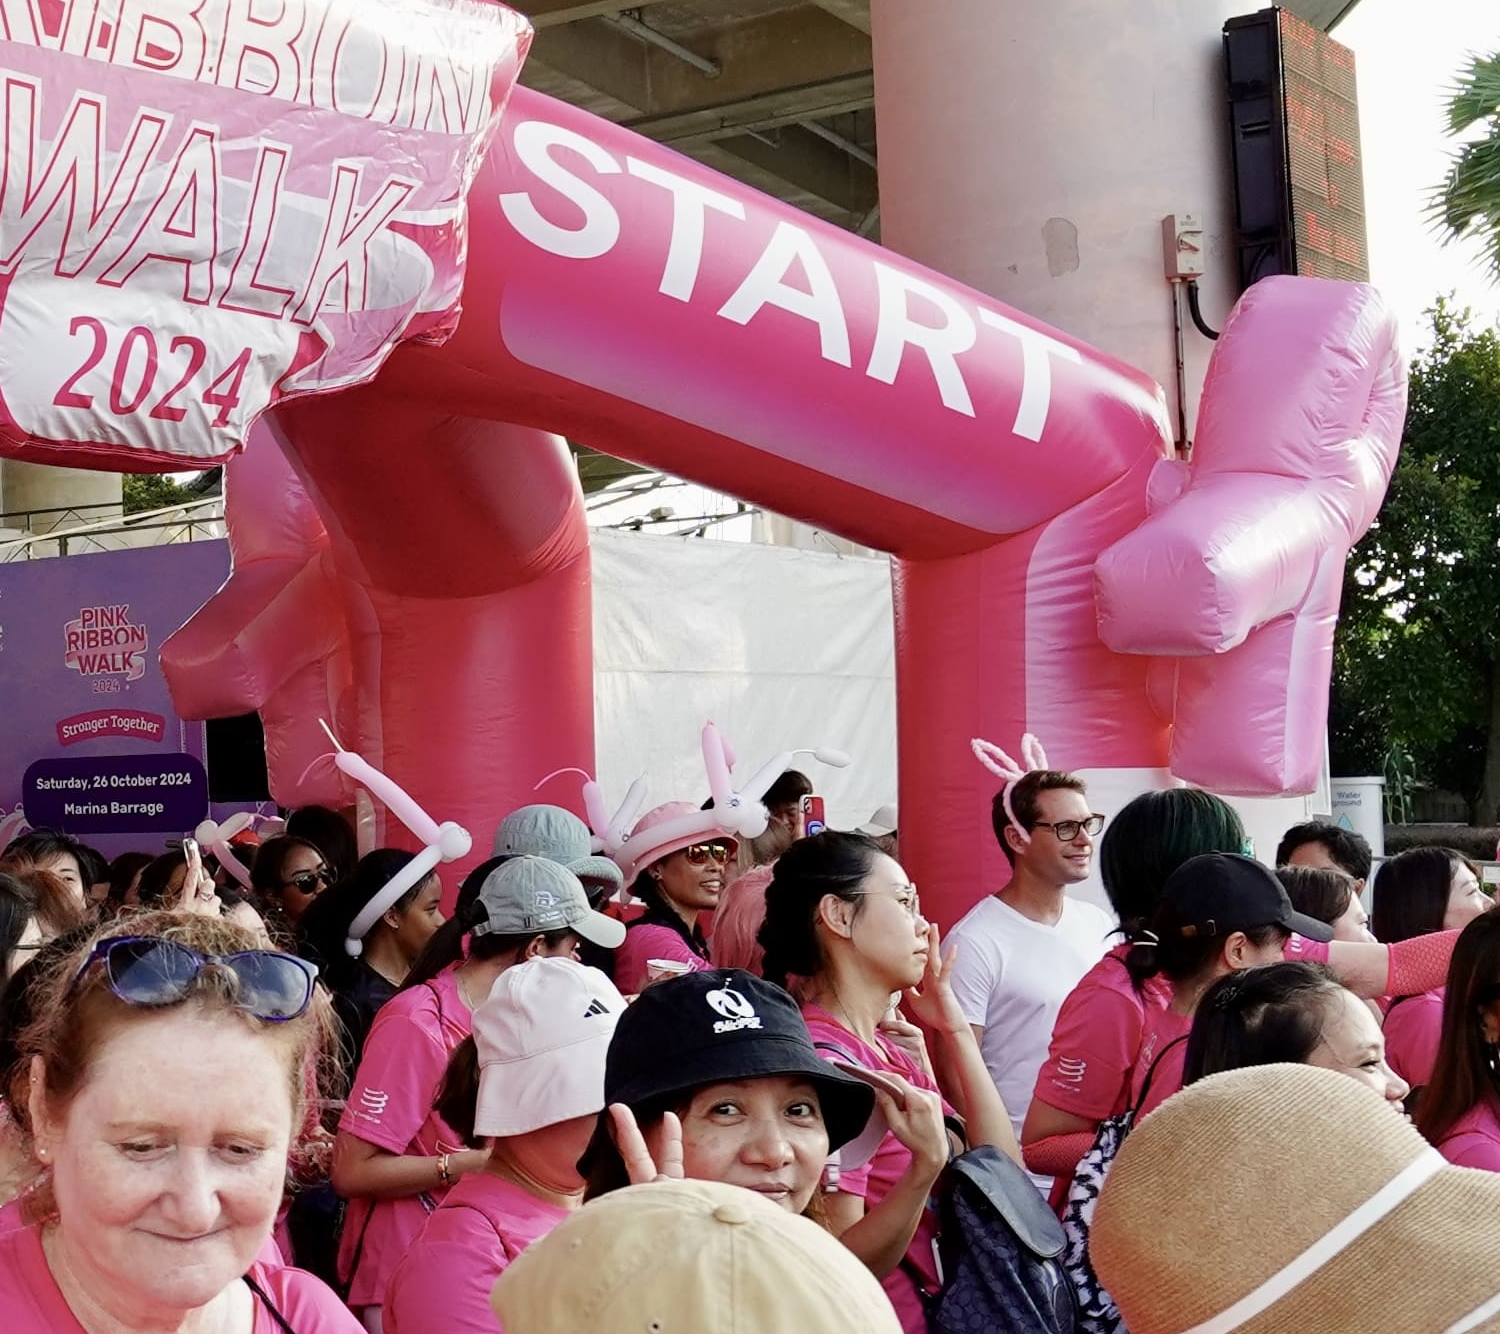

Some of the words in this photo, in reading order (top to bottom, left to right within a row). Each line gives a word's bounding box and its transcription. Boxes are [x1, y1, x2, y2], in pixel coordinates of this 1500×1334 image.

[498, 119, 1081, 443] START
[53, 315, 253, 428] 2024
[82, 605, 128, 628] PINK
[67, 625, 145, 651] RIBBON
[77, 651, 134, 674] WALK
[92, 679, 121, 693] 2024
[62, 717, 109, 738] Stronger
[110, 715, 160, 733] Together
[36, 777, 91, 790] Saturday,
[93, 776, 106, 787] 26
[110, 774, 158, 787] October
[160, 772, 192, 786] 2024
[64, 801, 108, 815] Marina
[110, 801, 164, 816] Barrage
